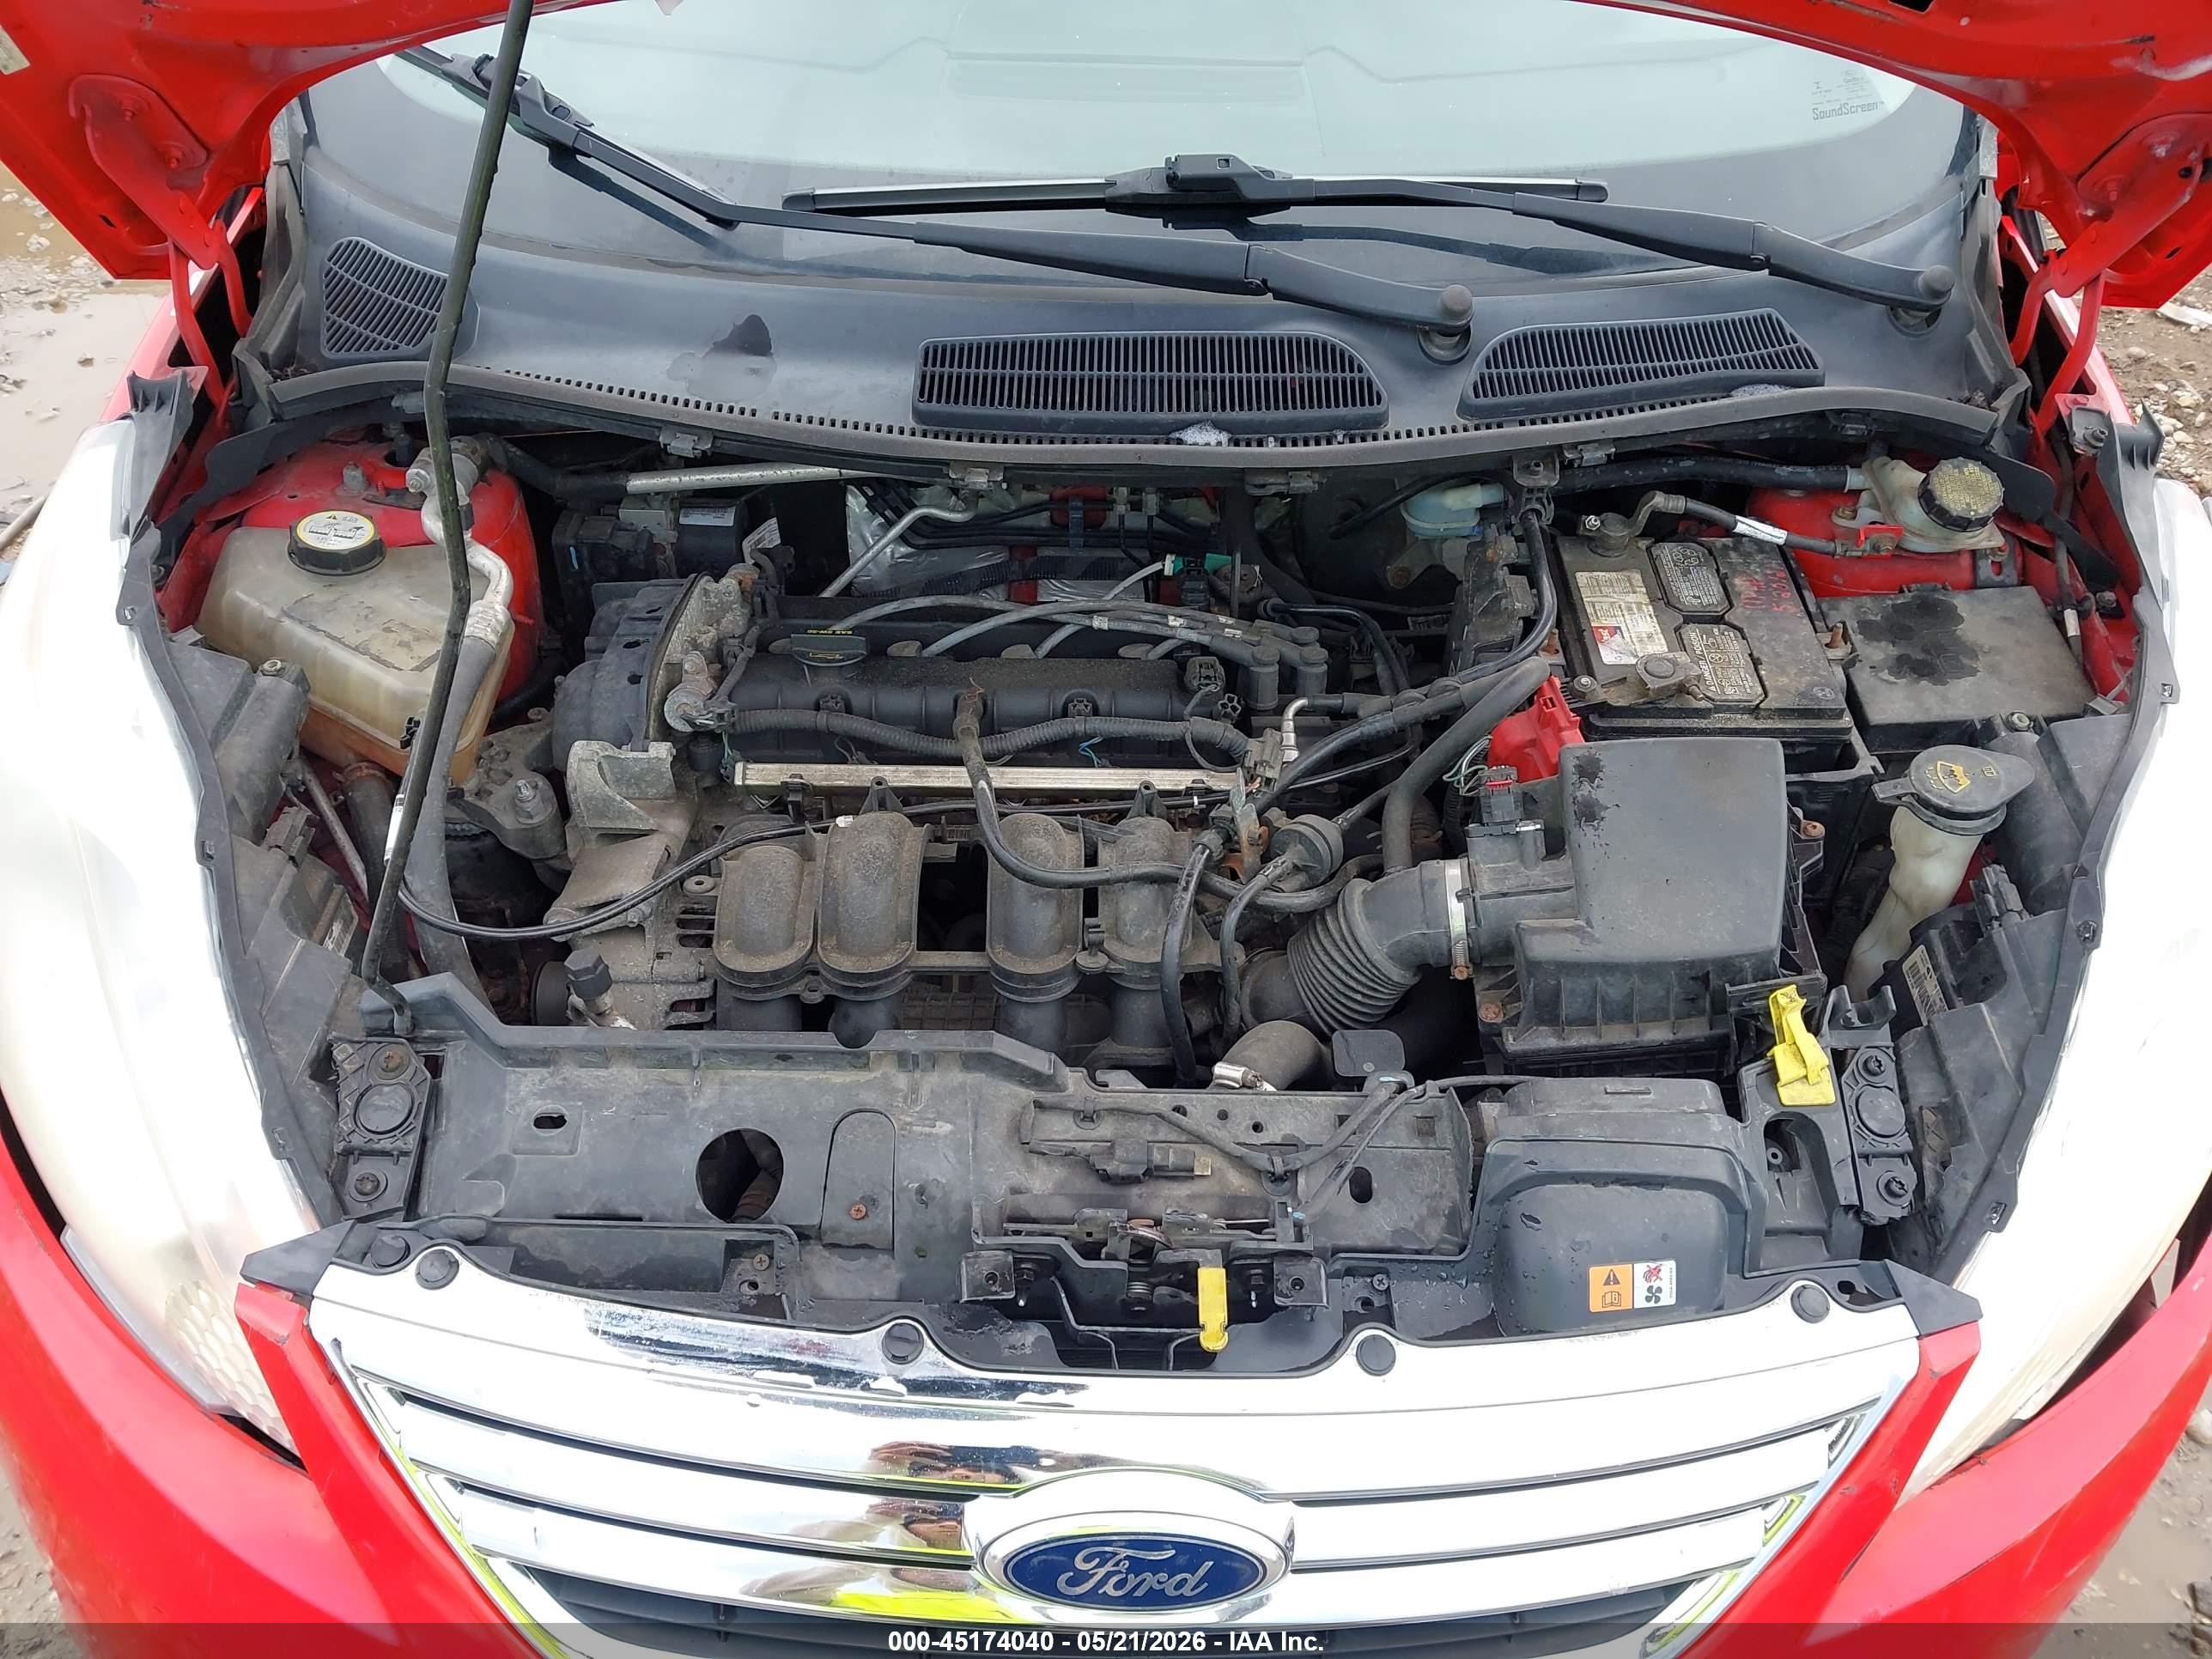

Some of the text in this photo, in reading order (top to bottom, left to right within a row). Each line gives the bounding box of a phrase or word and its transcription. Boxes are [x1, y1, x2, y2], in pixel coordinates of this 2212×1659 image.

[1812, 102, 1878, 120] SoundScreen
[1689, 632, 1704, 655] POISON
[1057, 1547, 1214, 1597] Ford
